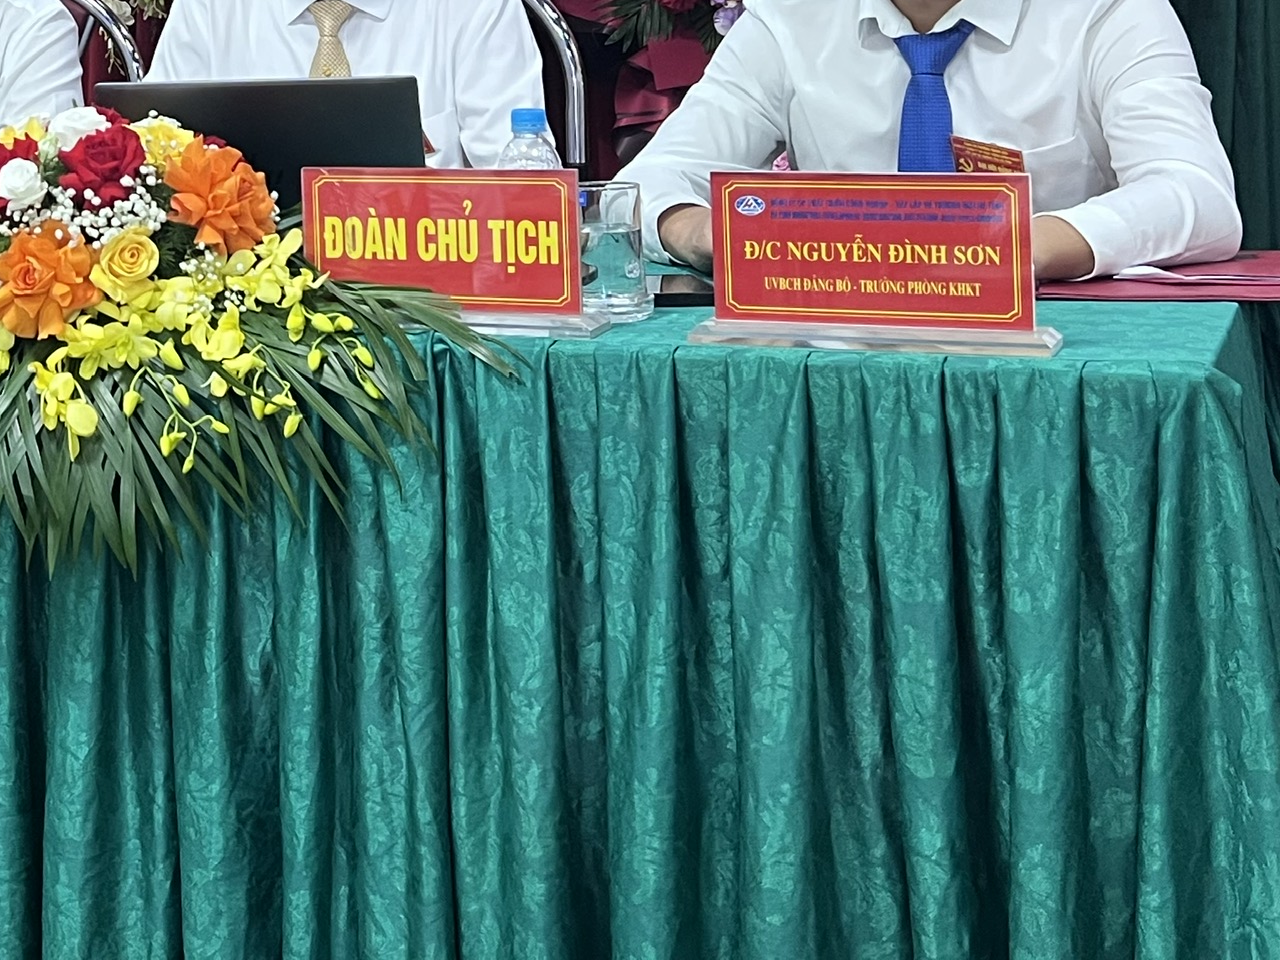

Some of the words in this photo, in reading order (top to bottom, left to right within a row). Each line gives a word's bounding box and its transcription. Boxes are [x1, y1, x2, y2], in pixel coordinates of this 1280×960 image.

[324, 208, 407, 260] ĐOÀN
[417, 200, 478, 262] CHỦ
[488, 220, 559, 273] TỊCH
[744, 240, 781, 260] Đ/C
[787, 234, 882, 263] NGUYỄN
[888, 238, 948, 265] ĐÌNH
[953, 244, 1000, 266] SƠN
[765, 276, 801, 290] UVBCH
[803, 274, 833, 292] ĐẢNG
[836, 276, 851, 295] BỘ
[859, 276, 905, 294] TRƯỞNG
[907, 278, 946, 295] PHÒNG
[948, 282, 982, 297] KHKT
